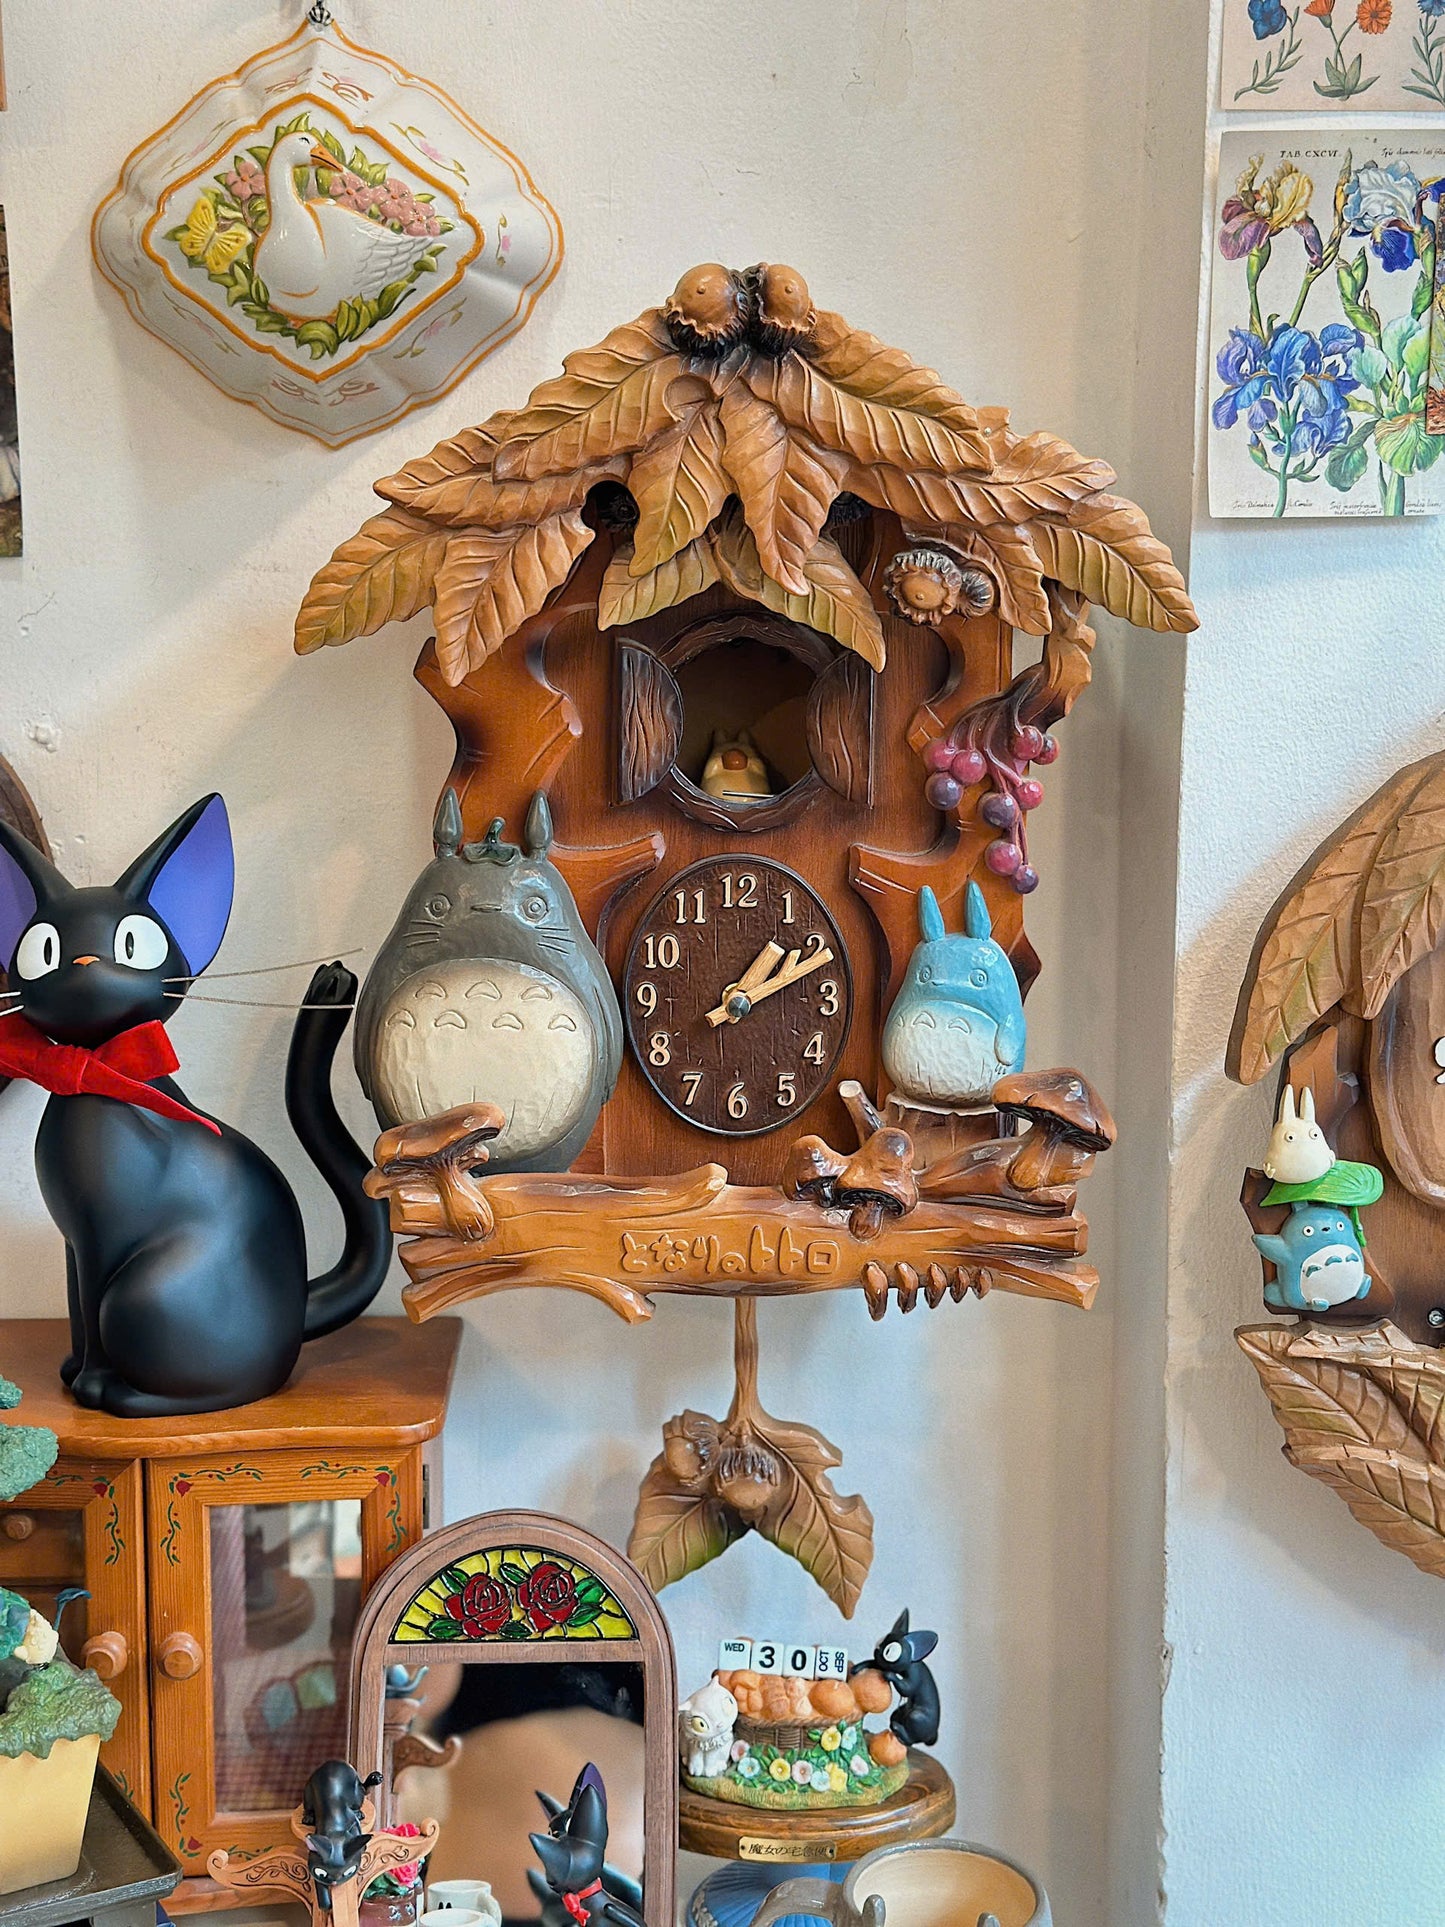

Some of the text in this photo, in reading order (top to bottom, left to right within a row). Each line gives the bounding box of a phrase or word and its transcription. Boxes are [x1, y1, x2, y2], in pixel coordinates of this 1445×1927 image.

[675, 889, 707, 924] 11
[720, 873, 758, 908] 12
[781, 889, 796, 924] 1
[644, 934, 680, 969] 10
[636, 982, 658, 1018] 9
[818, 980, 839, 1016] 3
[649, 1032, 671, 1067] 8
[803, 1032, 826, 1065] 4
[682, 1072, 703, 1106] 7
[727, 1082, 749, 1119] 6
[777, 1072, 797, 1107] 5
[620, 1224, 841, 1275] となりのトトロ
[724, 1642, 745, 1653] WED
[818, 1650, 829, 1672] OCT
[834, 1651, 845, 1673] SEP
